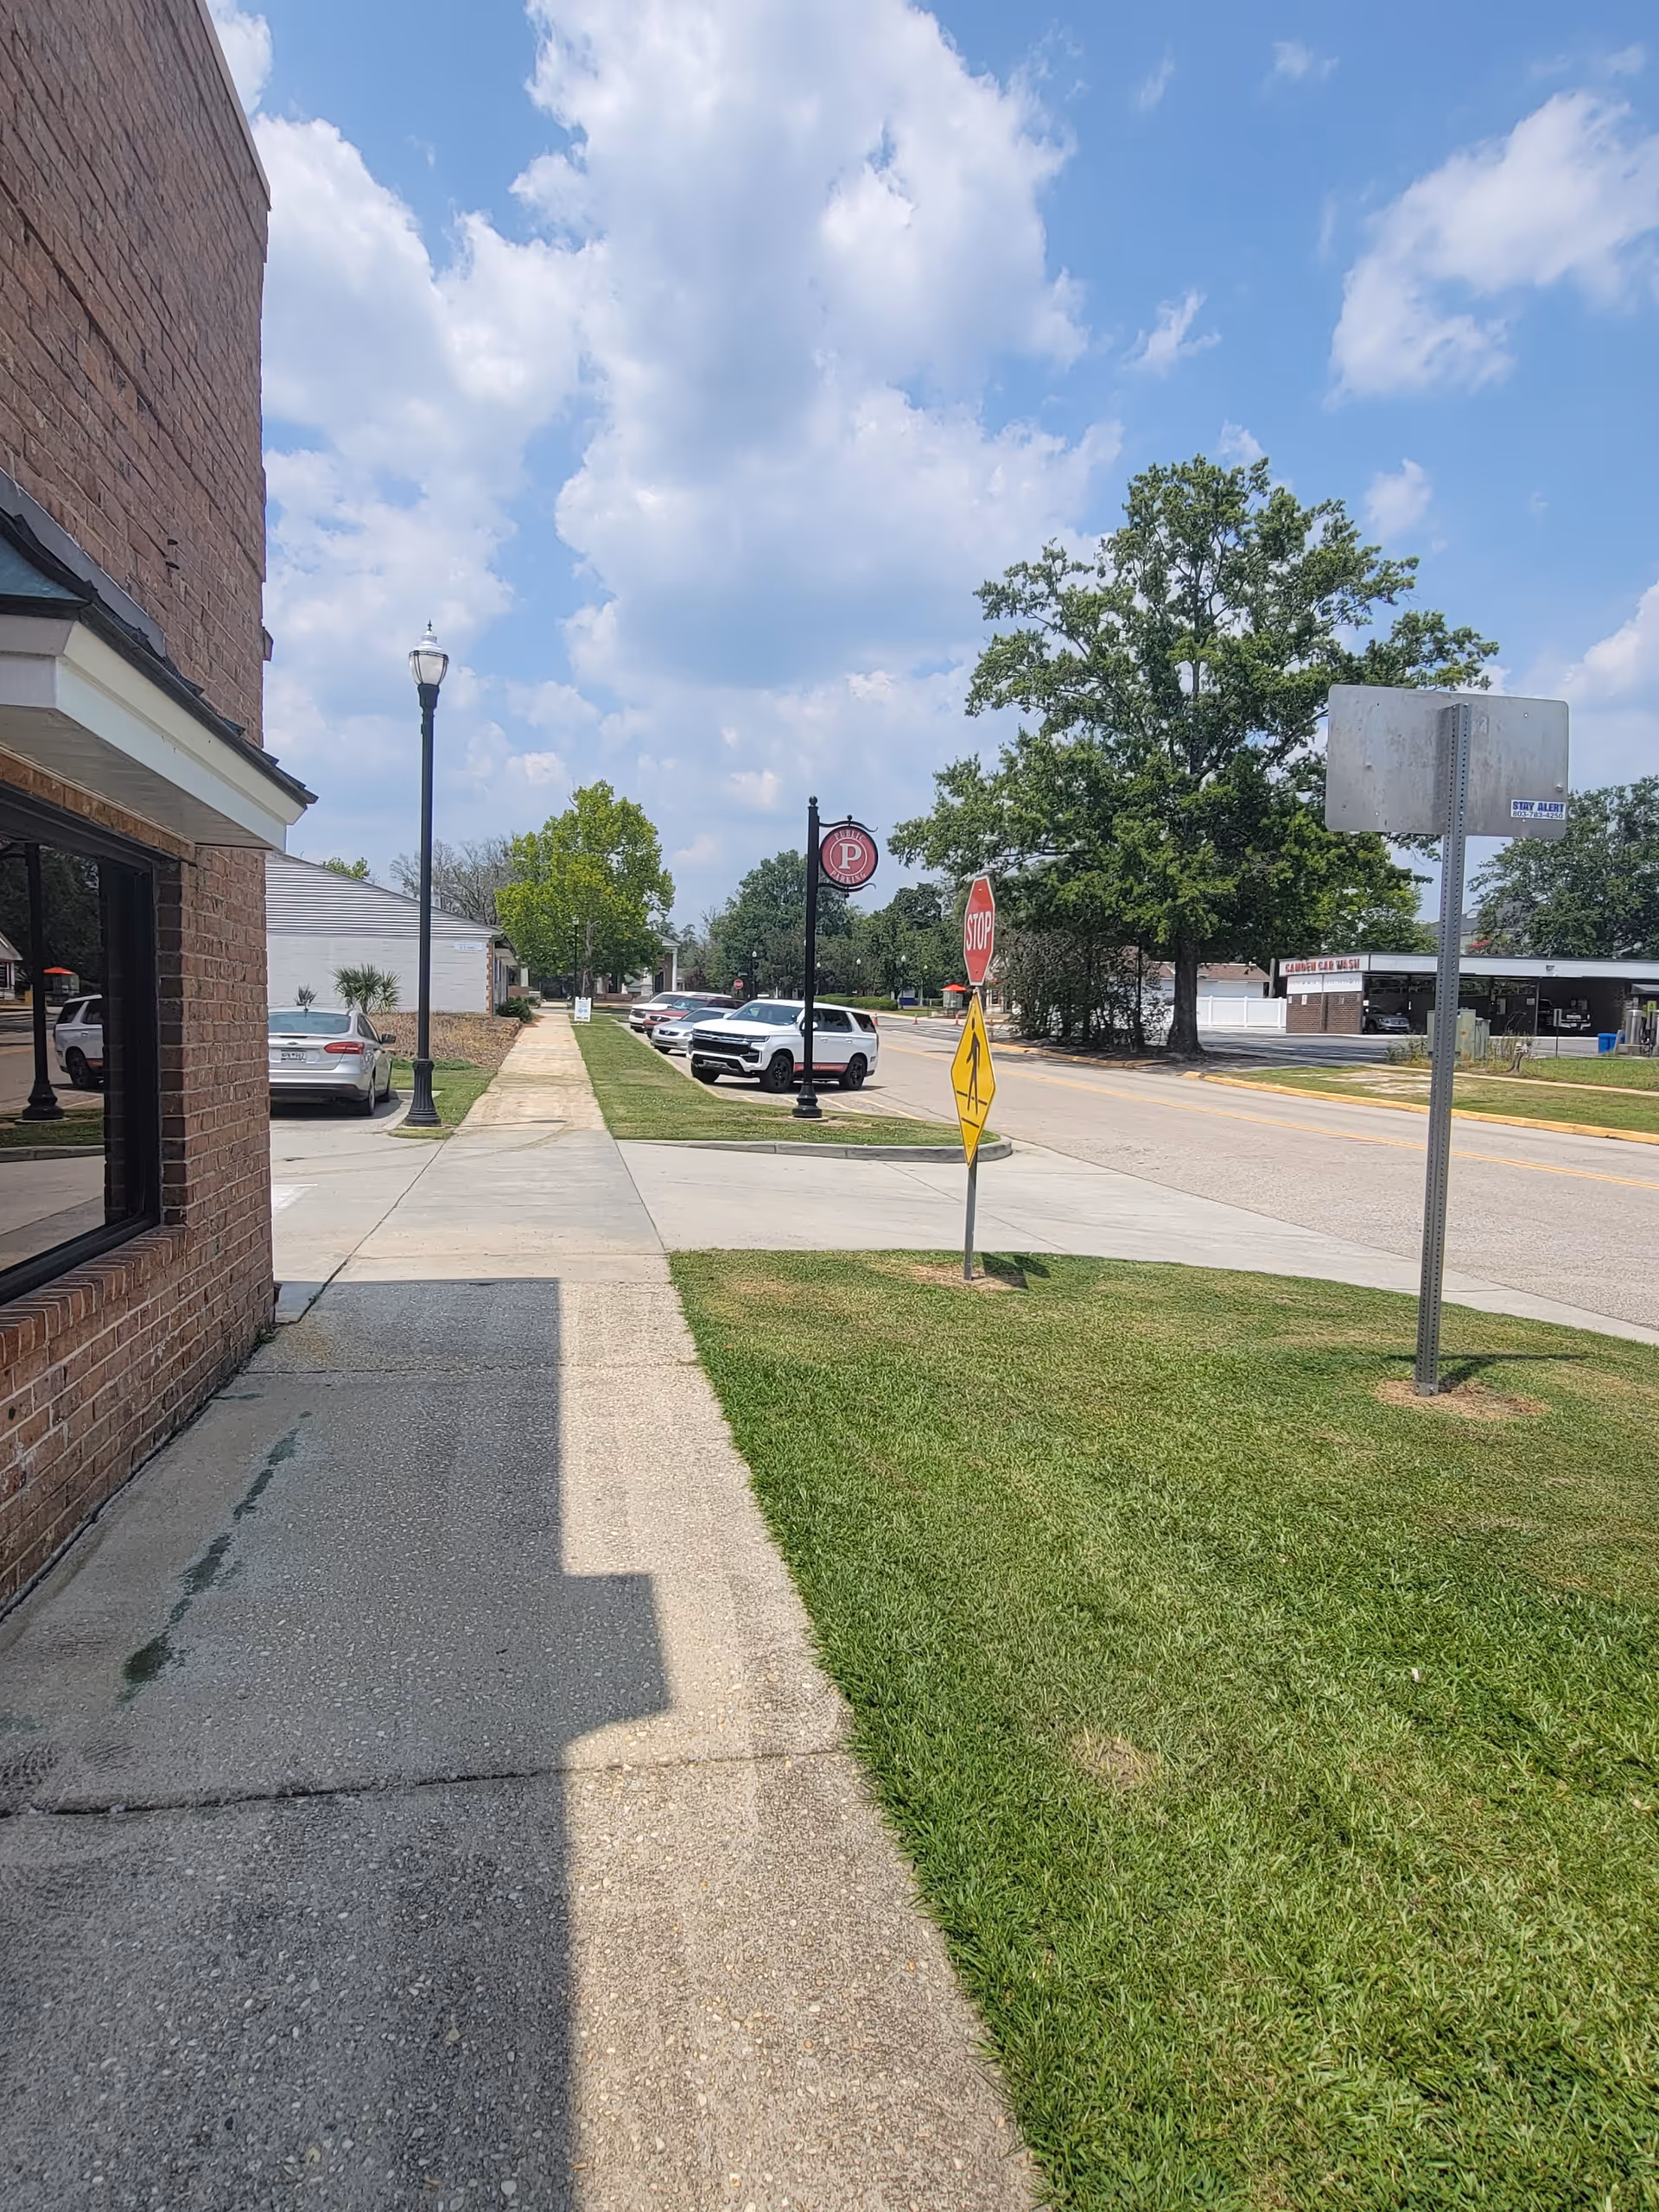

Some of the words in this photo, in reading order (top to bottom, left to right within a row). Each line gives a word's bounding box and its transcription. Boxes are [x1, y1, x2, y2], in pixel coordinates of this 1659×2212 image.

[1512, 801, 1535, 810] STAY
[1537, 803, 1565, 812] ALERT
[834, 830, 866, 841] PUBLIC
[838, 842, 861, 869] P
[830, 869, 866, 884] PARKING
[966, 911, 992, 950] STOP
[1285, 961, 1317, 973] CAMDEN
[1318, 960, 1334, 970] CAR
[1336, 958, 1360, 970] WASH
